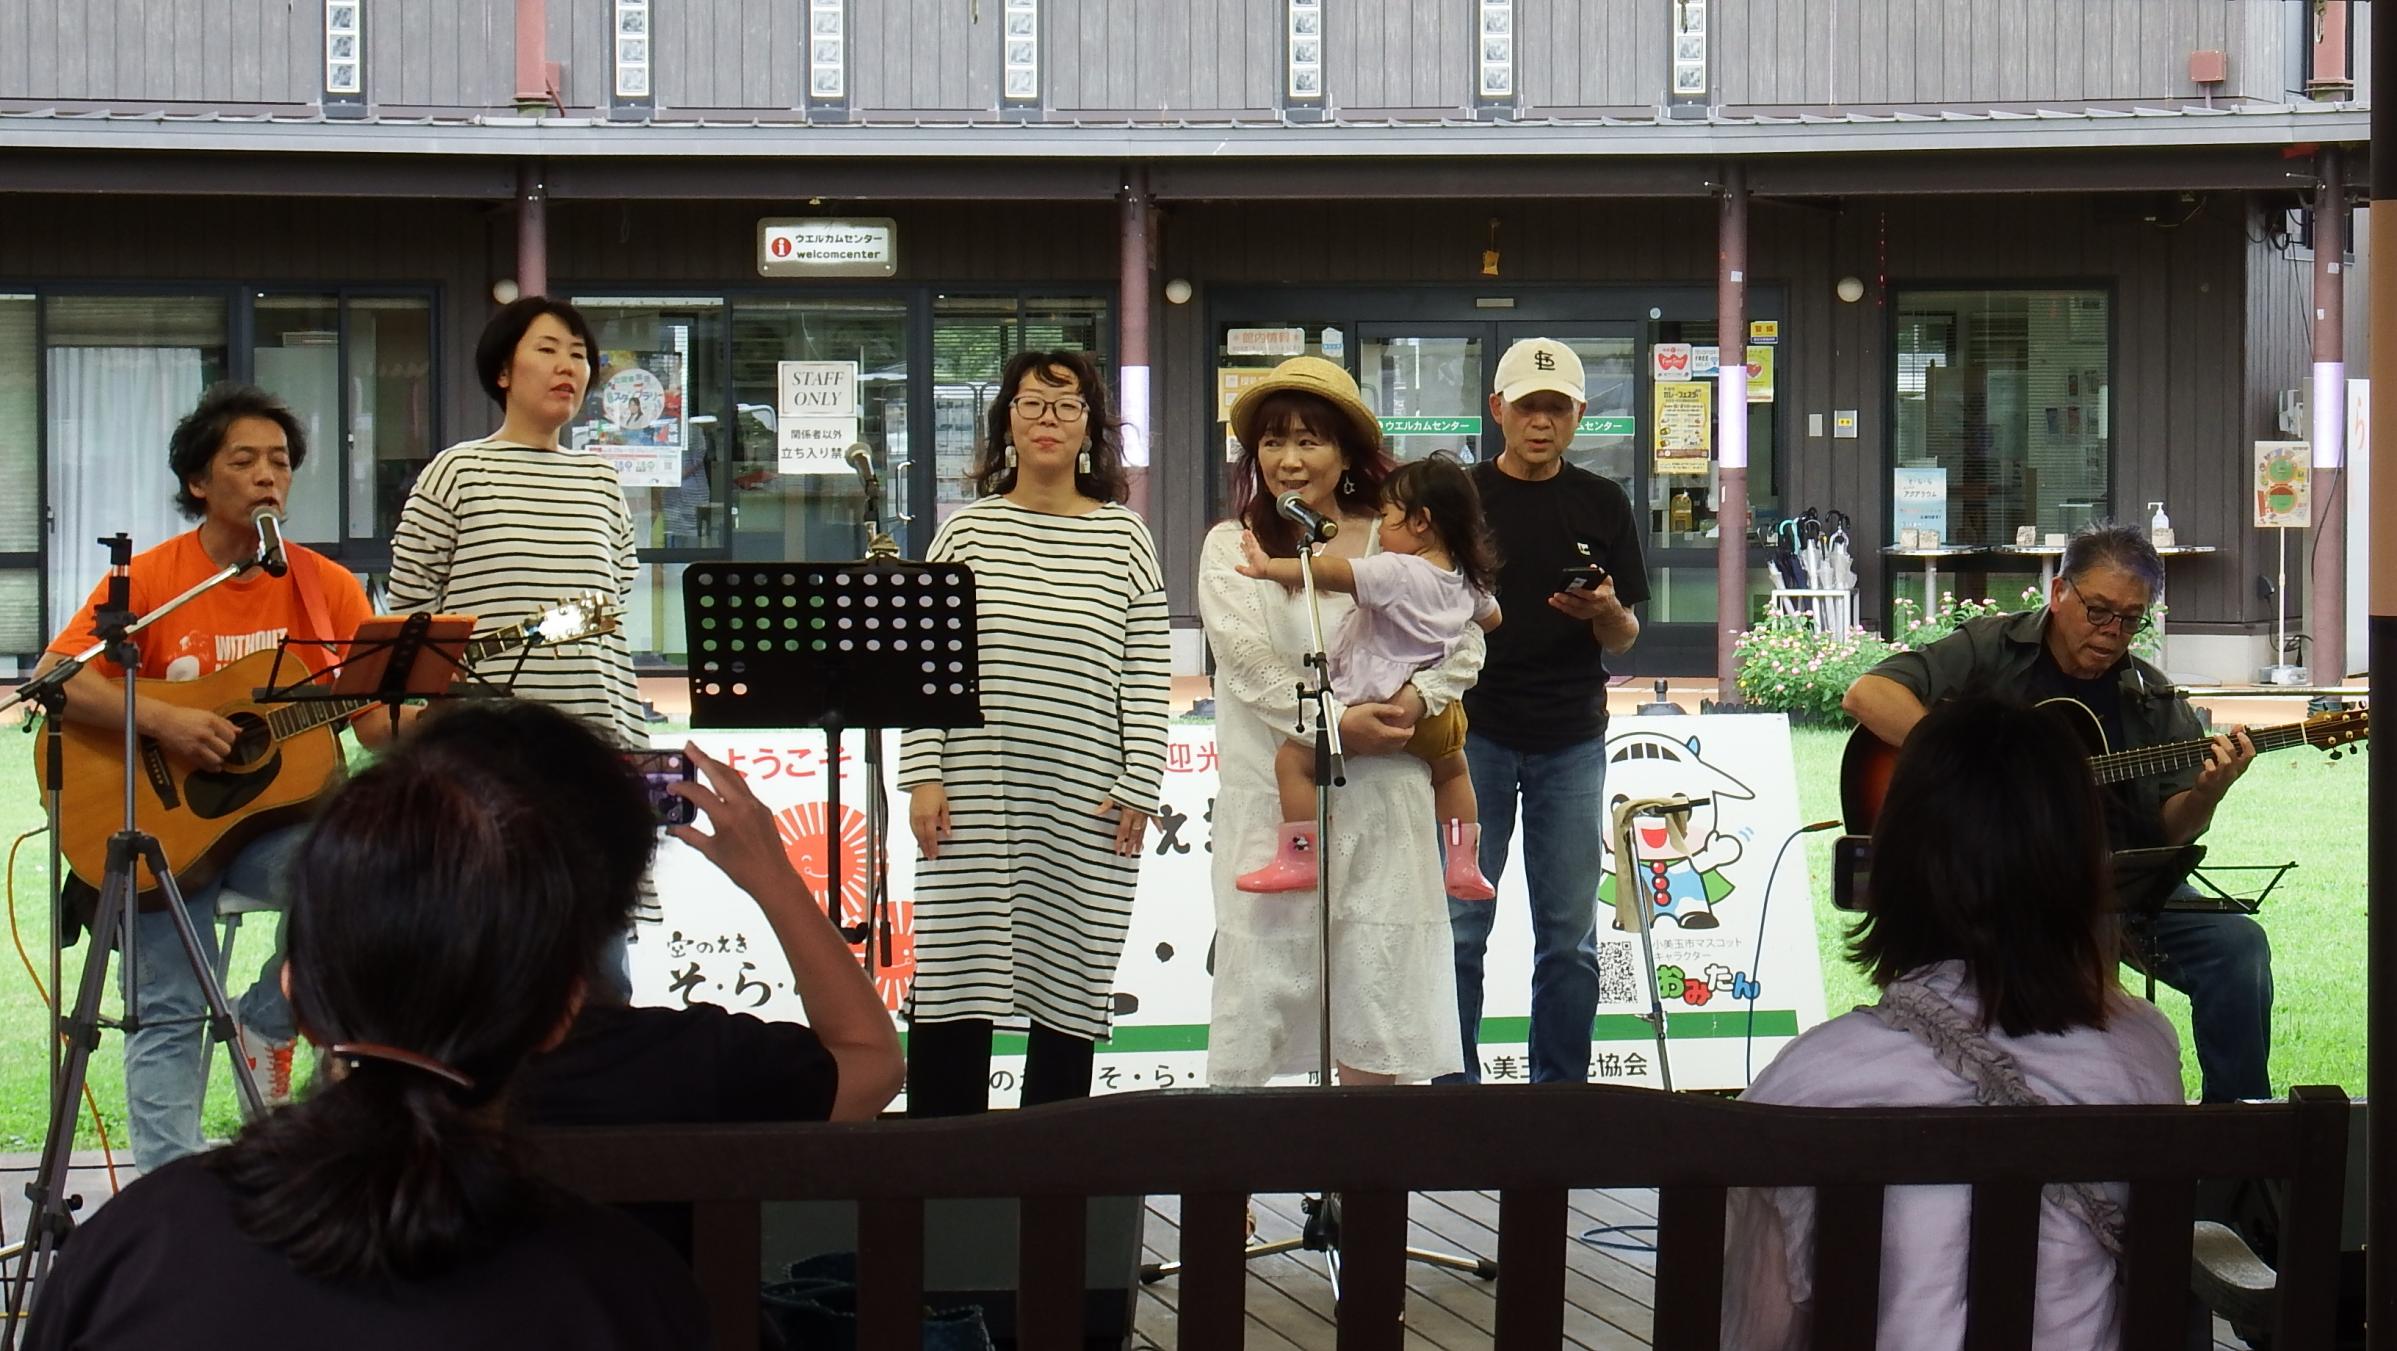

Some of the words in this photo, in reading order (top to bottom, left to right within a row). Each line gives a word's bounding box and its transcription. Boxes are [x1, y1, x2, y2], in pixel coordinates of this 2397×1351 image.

[795, 234, 883, 244] ウエルカムセンター
[796, 249, 881, 259] welcomcenter
[792, 371, 845, 386] STAFF
[794, 391, 842, 406] ONLY
[1385, 421, 1470, 431] ウエルカムセンター
[790, 429, 842, 440] 関係者以外
[781, 447, 845, 460] 立ち入り禁
[667, 930, 748, 958] 空のえき
[1653, 938, 1743, 950] 小美玉市マスコット
[1654, 951, 1712, 961] キャラクター
[668, 961, 800, 1008] そ・ら・
[1656, 963, 1761, 1007] おみたん
